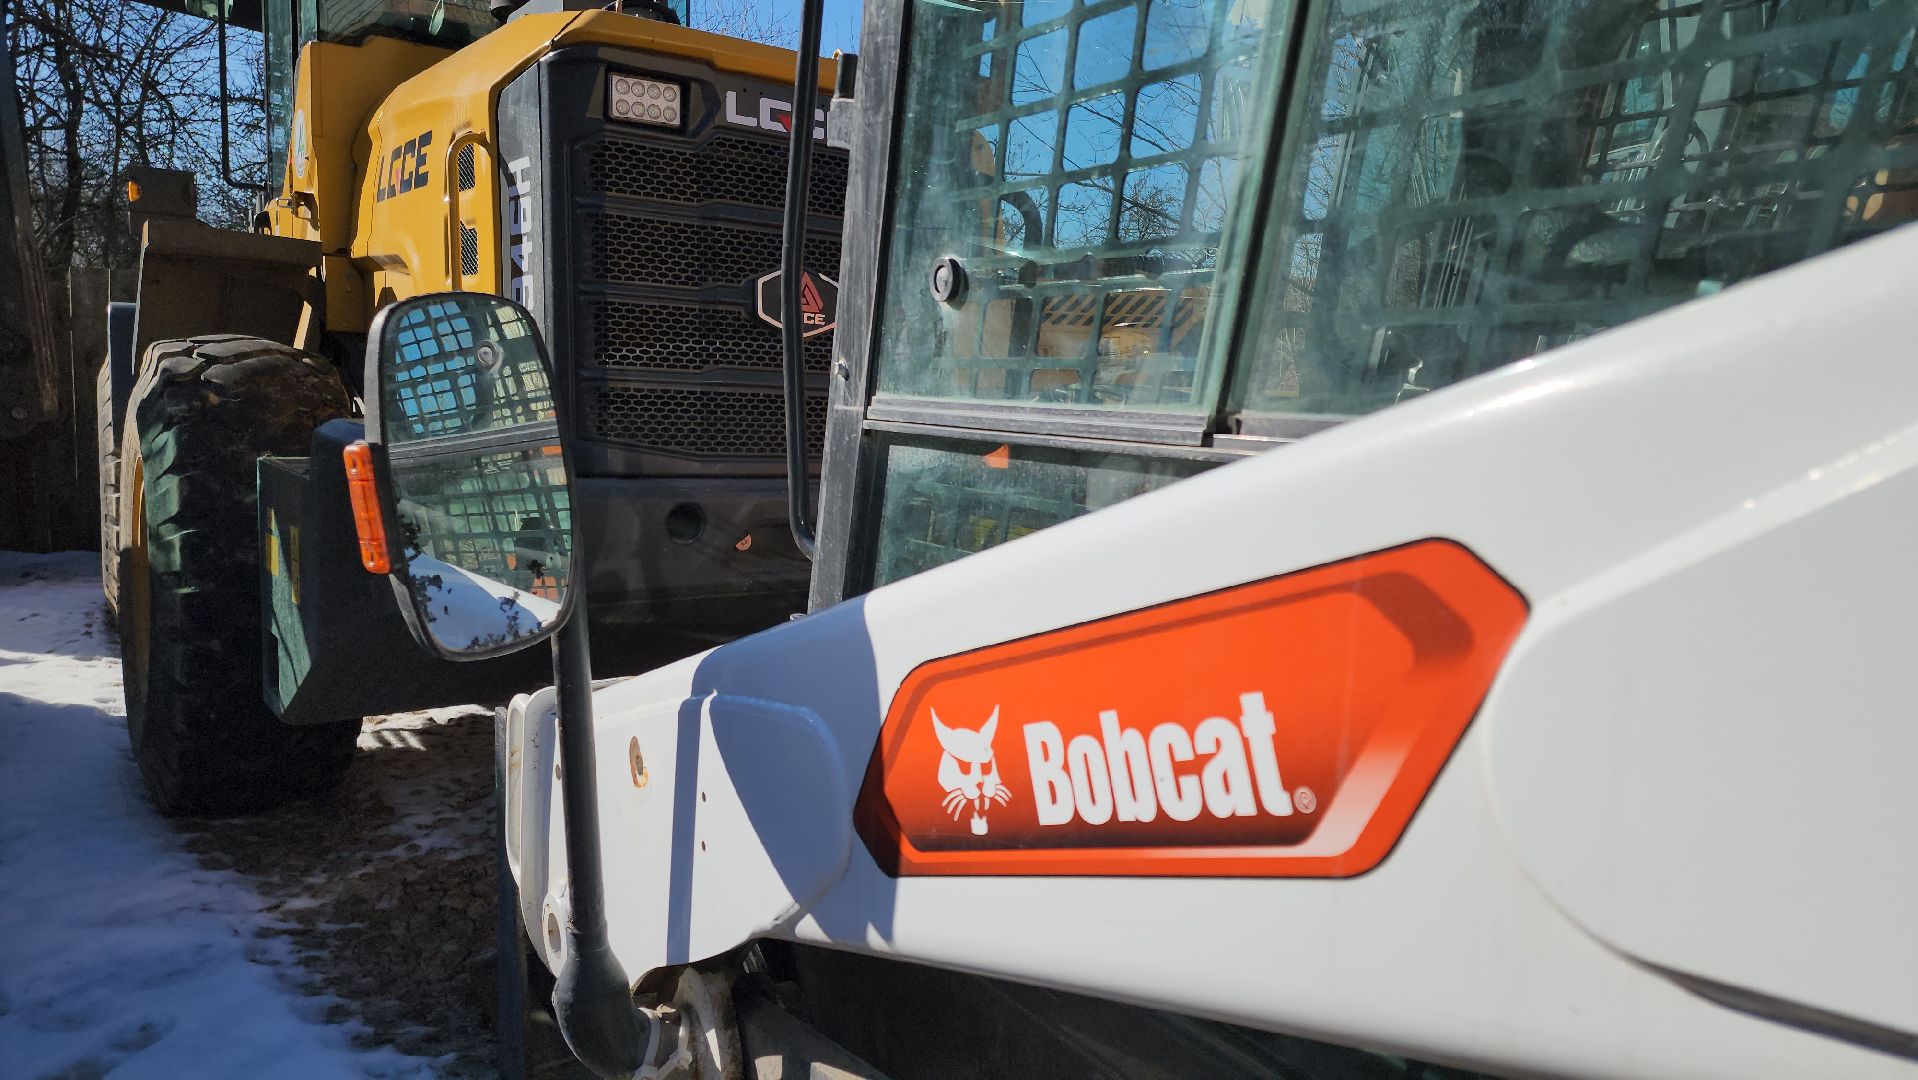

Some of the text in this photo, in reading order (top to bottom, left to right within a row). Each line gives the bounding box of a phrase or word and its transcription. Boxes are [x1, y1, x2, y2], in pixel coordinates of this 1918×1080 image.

[377, 130, 433, 203] LGCE
[508, 156, 534, 311] 946H
[803, 312, 826, 325] CE
